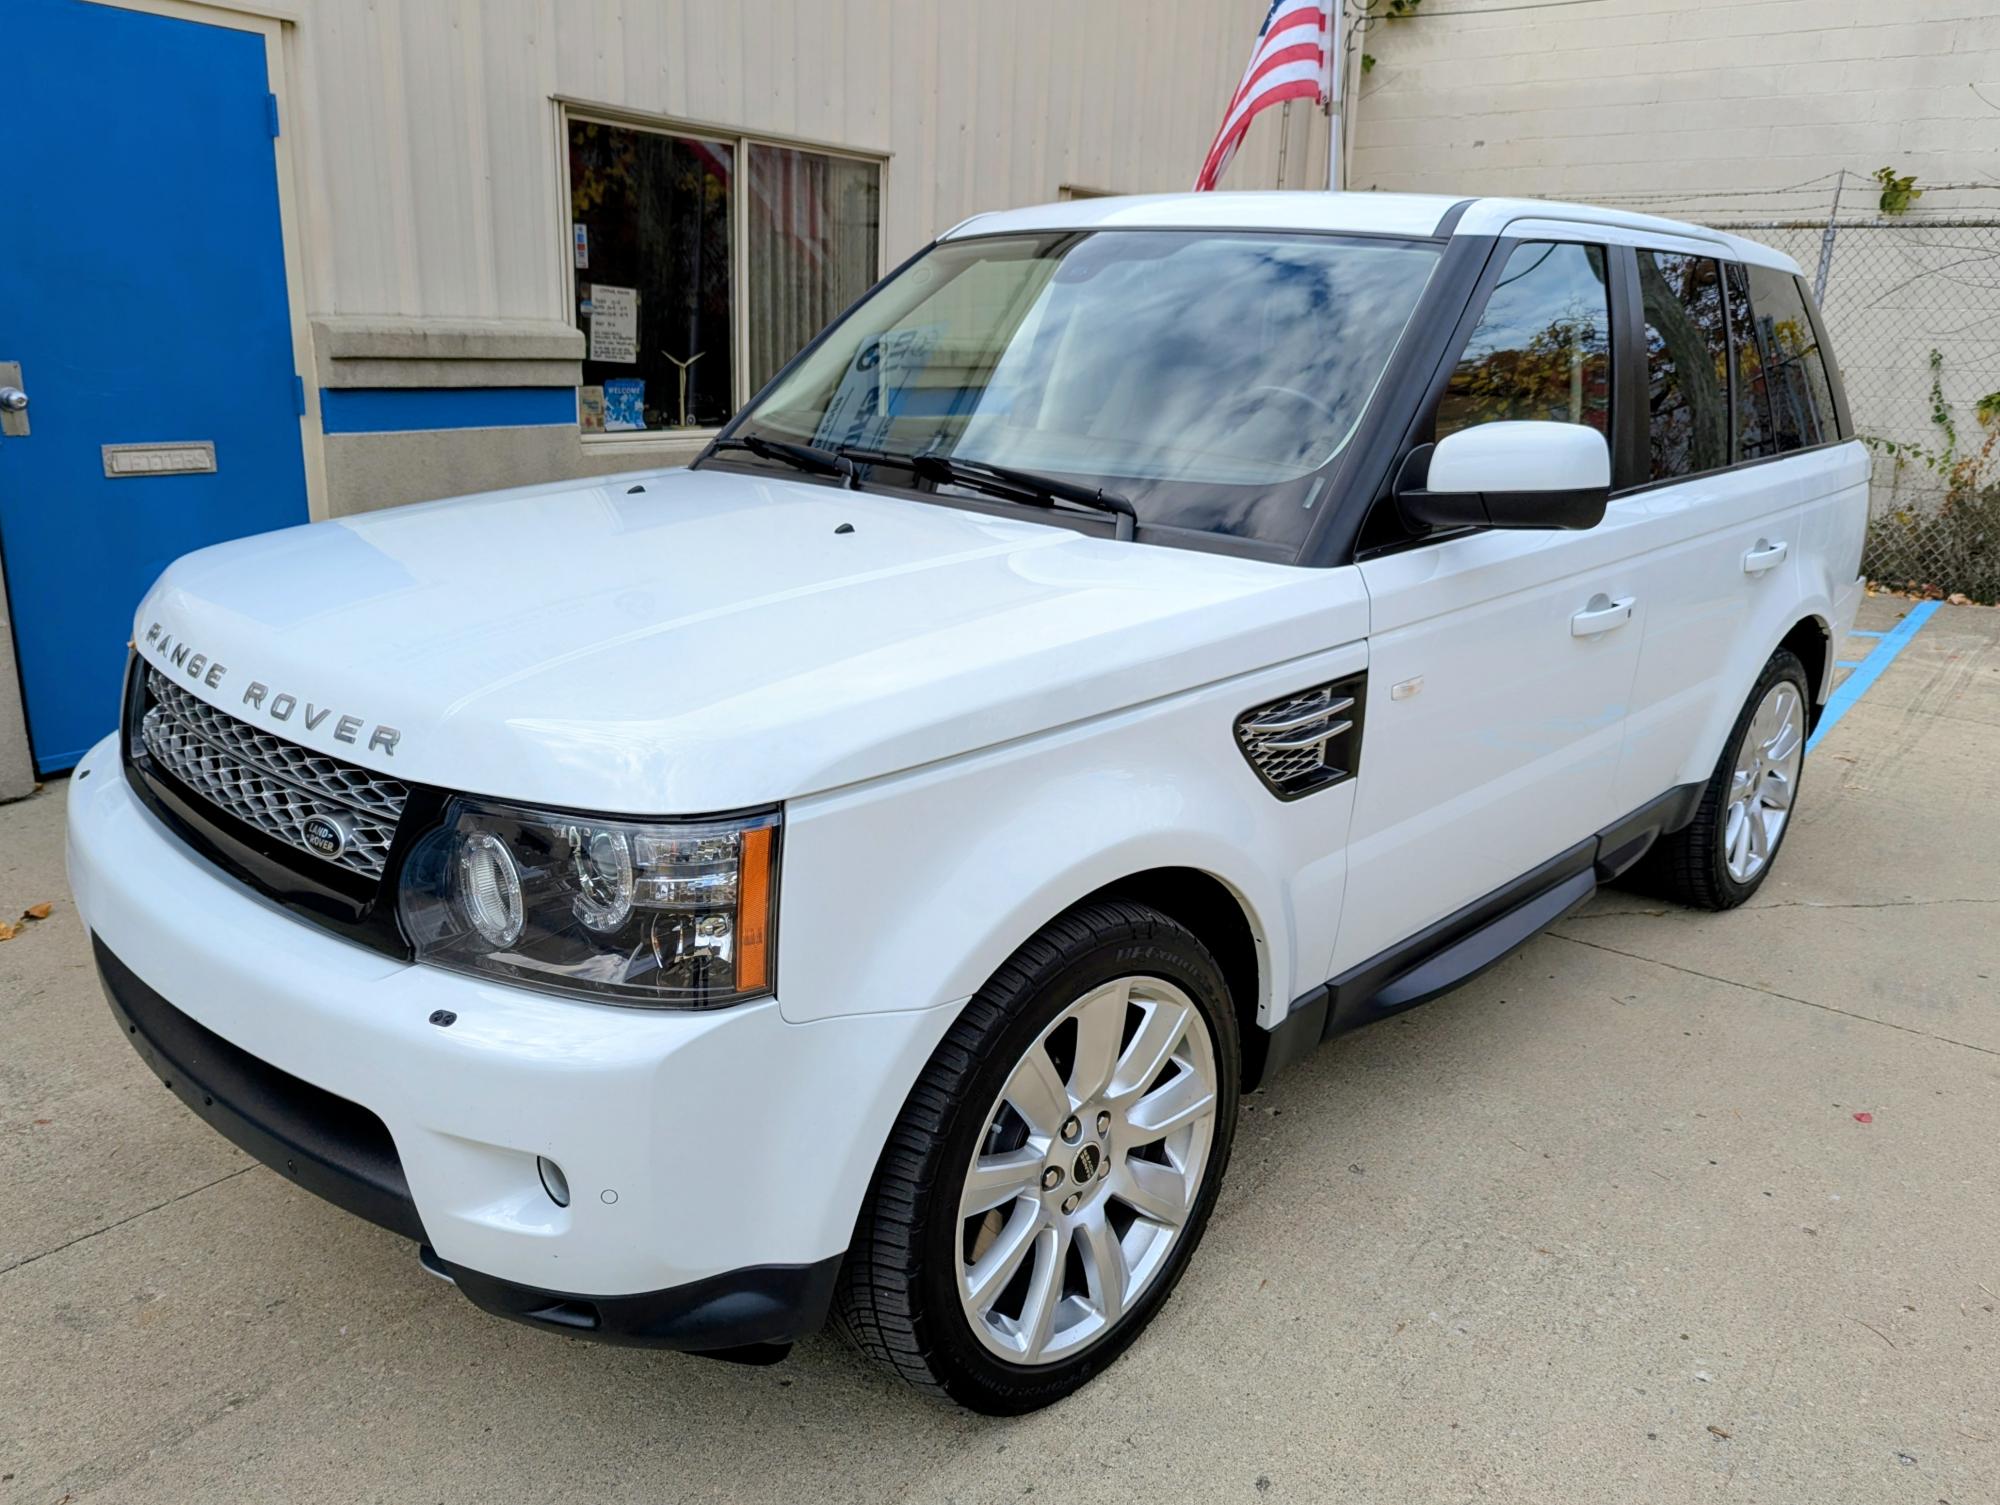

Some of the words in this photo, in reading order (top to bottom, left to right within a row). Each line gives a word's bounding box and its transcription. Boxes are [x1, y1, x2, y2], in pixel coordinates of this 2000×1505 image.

[145, 622, 228, 689] RANGE
[242, 680, 401, 757] ROVER
[308, 822, 329, 838] LAND
[309, 834, 334, 852] ROVER
